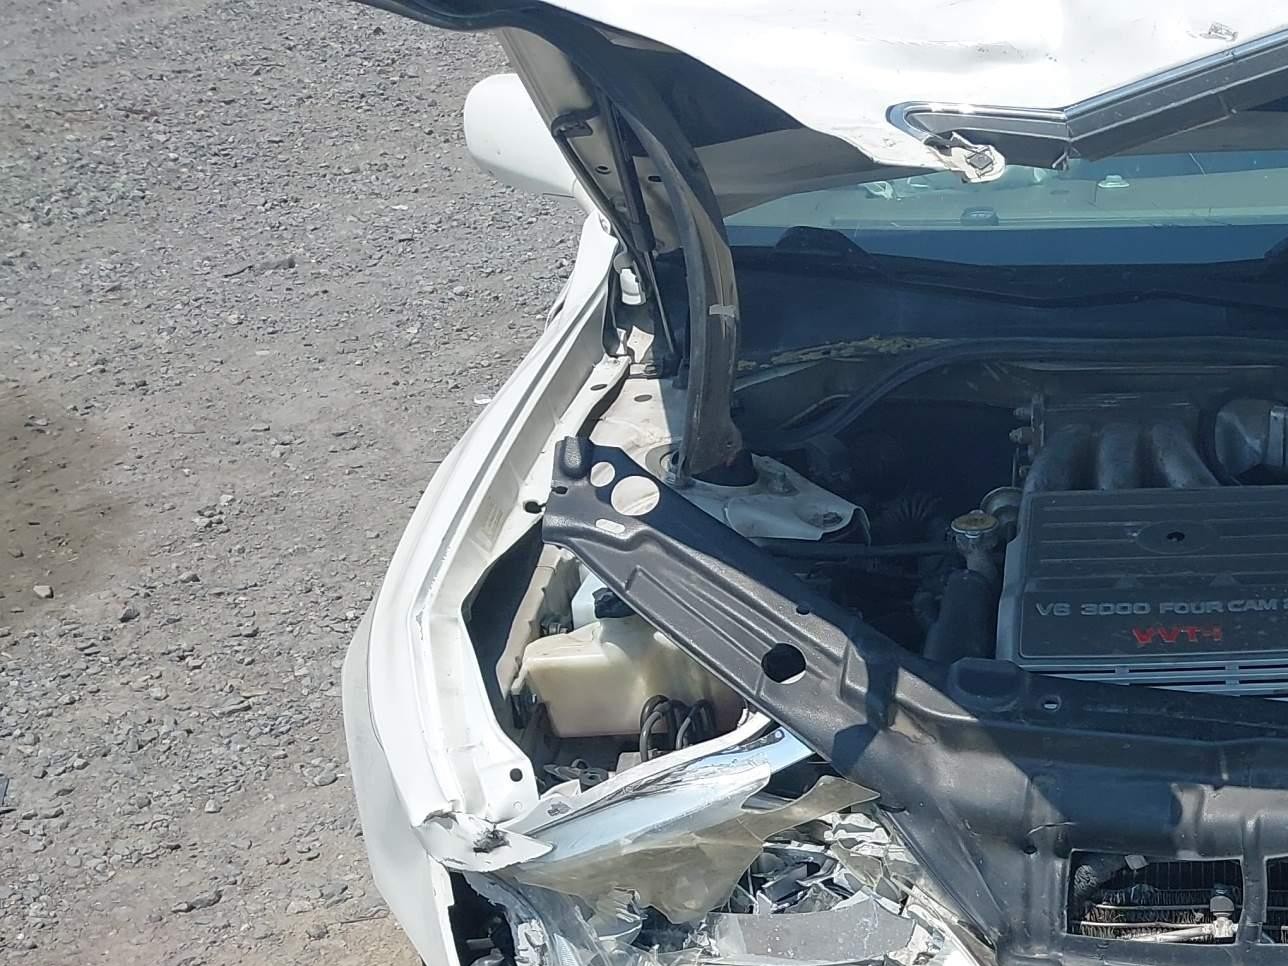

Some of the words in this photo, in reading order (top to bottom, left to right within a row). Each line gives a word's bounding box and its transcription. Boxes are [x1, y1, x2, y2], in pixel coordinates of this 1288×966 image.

[1035, 602, 1071, 617] V6
[1080, 602, 1151, 616] 3000
[1159, 601, 1224, 614] FOUR
[1227, 598, 1278, 612] CAM
